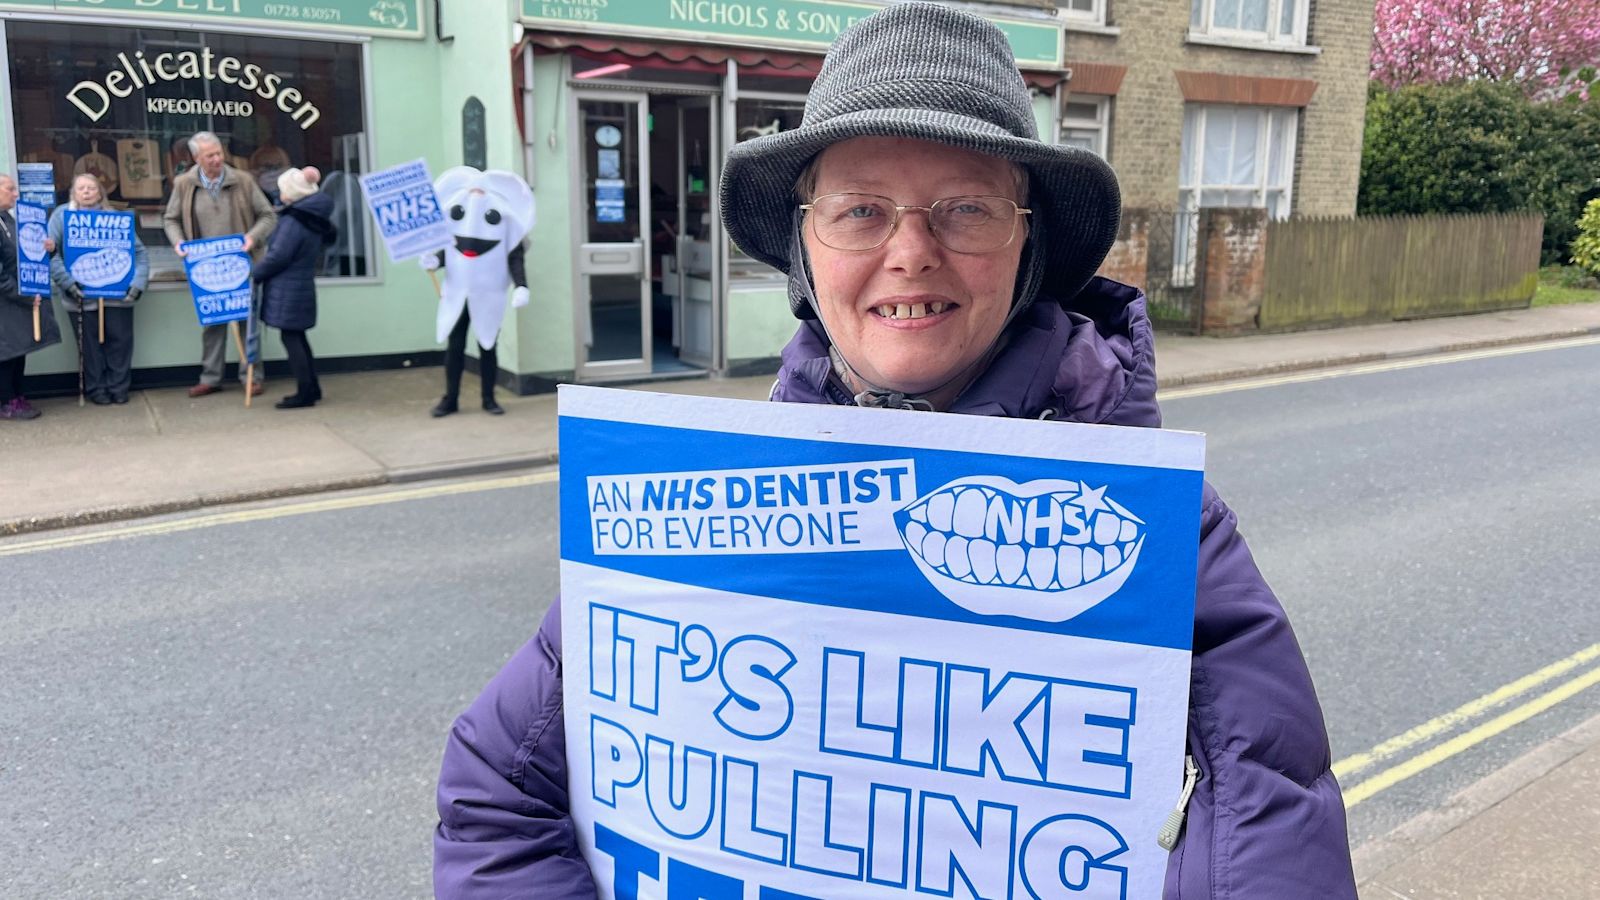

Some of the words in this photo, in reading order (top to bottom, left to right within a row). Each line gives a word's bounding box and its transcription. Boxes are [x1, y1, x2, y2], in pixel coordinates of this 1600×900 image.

[569, 7, 599, 21] 1895
[669, 0, 769, 28] NICHOLS
[775, 9, 791, 30] &
[797, 11, 841, 35] SON
[65, 46, 321, 130] Delicatessen
[67, 213, 92, 227] AN
[94, 214, 132, 229] NHS
[379, 193, 437, 226] NHS
[68, 226, 131, 240] DENTIST
[199, 299, 223, 315] ON
[592, 481, 632, 513] AN
[641, 477, 717, 512] NHS
[724, 467, 909, 510] DENTIST
[595, 517, 654, 549] FOR
[664, 510, 862, 549] EVERYONE
[985, 494, 1092, 547] NHS
[589, 601, 798, 741] IT'S
[818, 646, 1138, 800] LIKE
[590, 713, 1130, 900] PULLING
